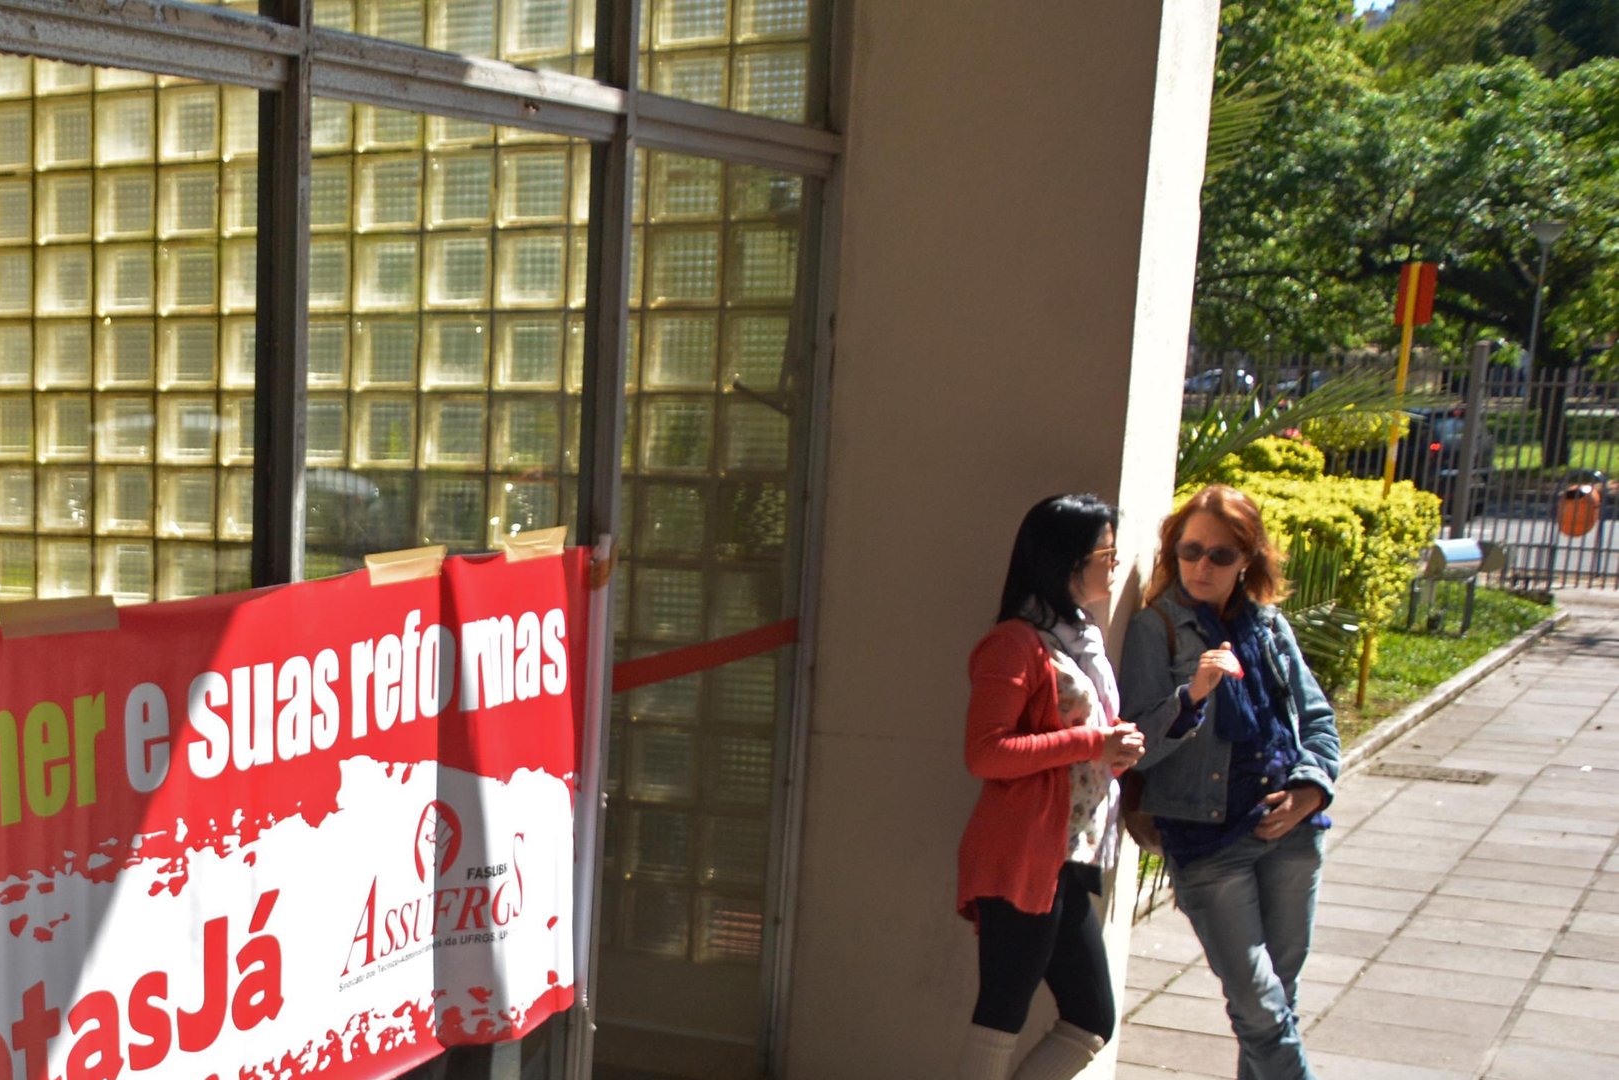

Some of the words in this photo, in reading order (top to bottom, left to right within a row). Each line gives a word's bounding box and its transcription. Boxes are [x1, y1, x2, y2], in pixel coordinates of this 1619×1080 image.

[124, 682, 170, 793] e
[187, 646, 340, 779] suas
[350, 607, 568, 740] reformas
